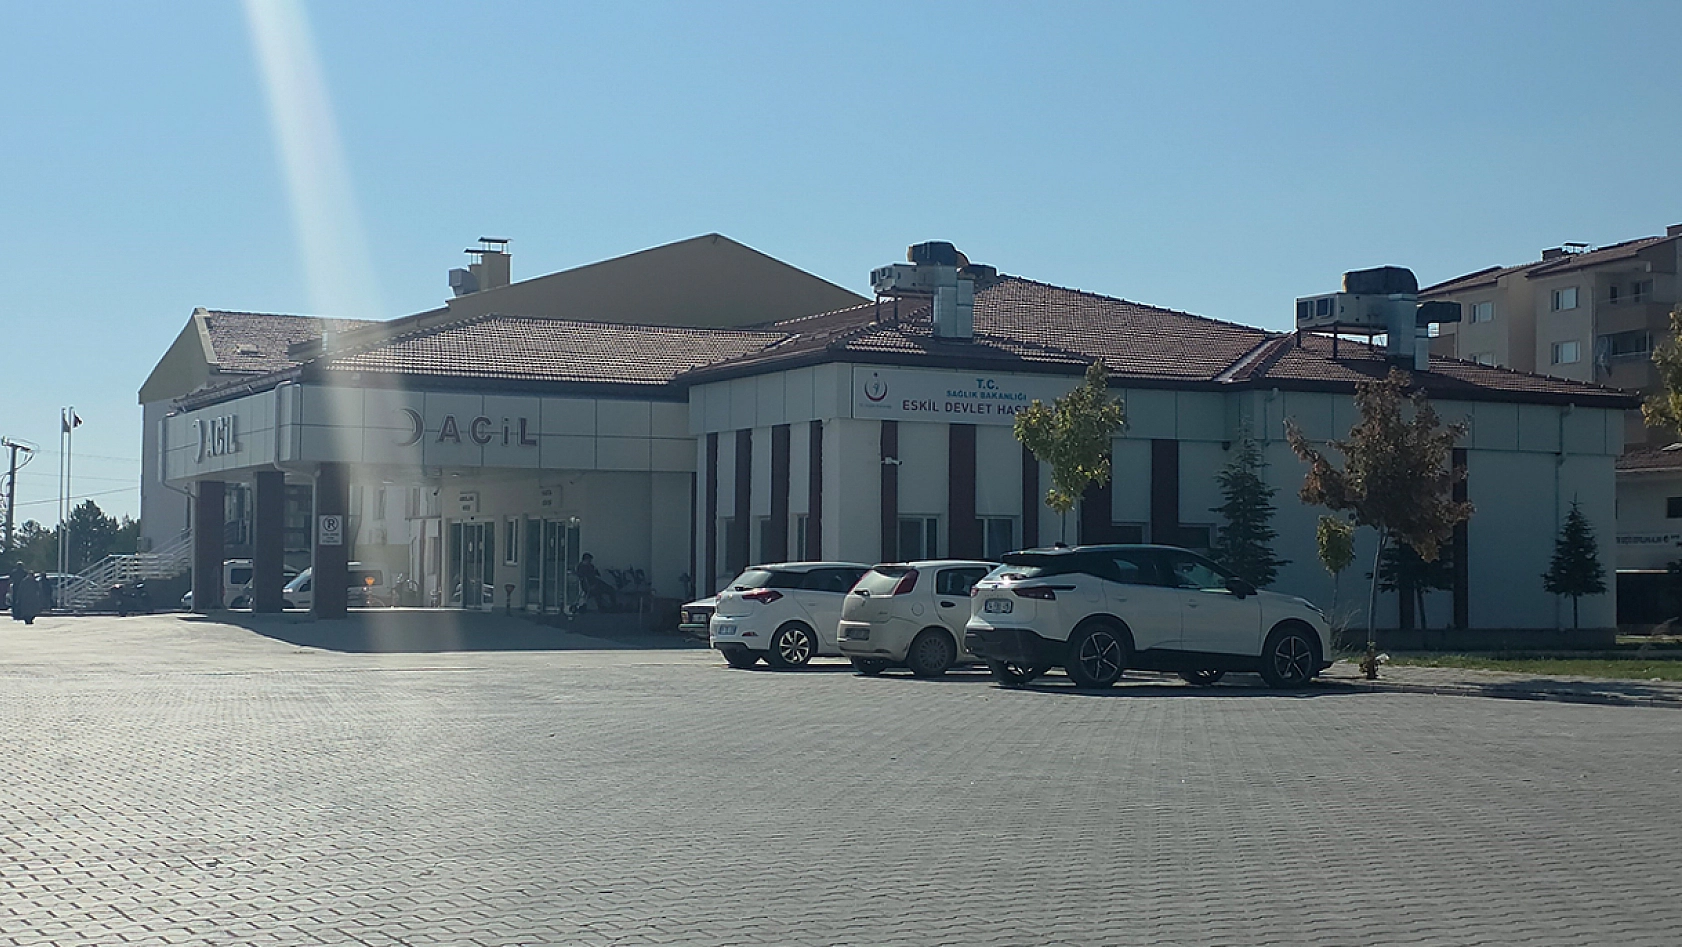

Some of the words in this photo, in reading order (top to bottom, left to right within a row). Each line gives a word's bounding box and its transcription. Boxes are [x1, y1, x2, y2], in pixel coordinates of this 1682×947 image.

[976, 378, 1000, 390] T.C.
[946, 389, 978, 399] SAĞLIK
[980, 391, 1027, 401] BAKANLIĞI
[902, 399, 939, 412] ESKİL
[945, 402, 993, 415] DEVLET
